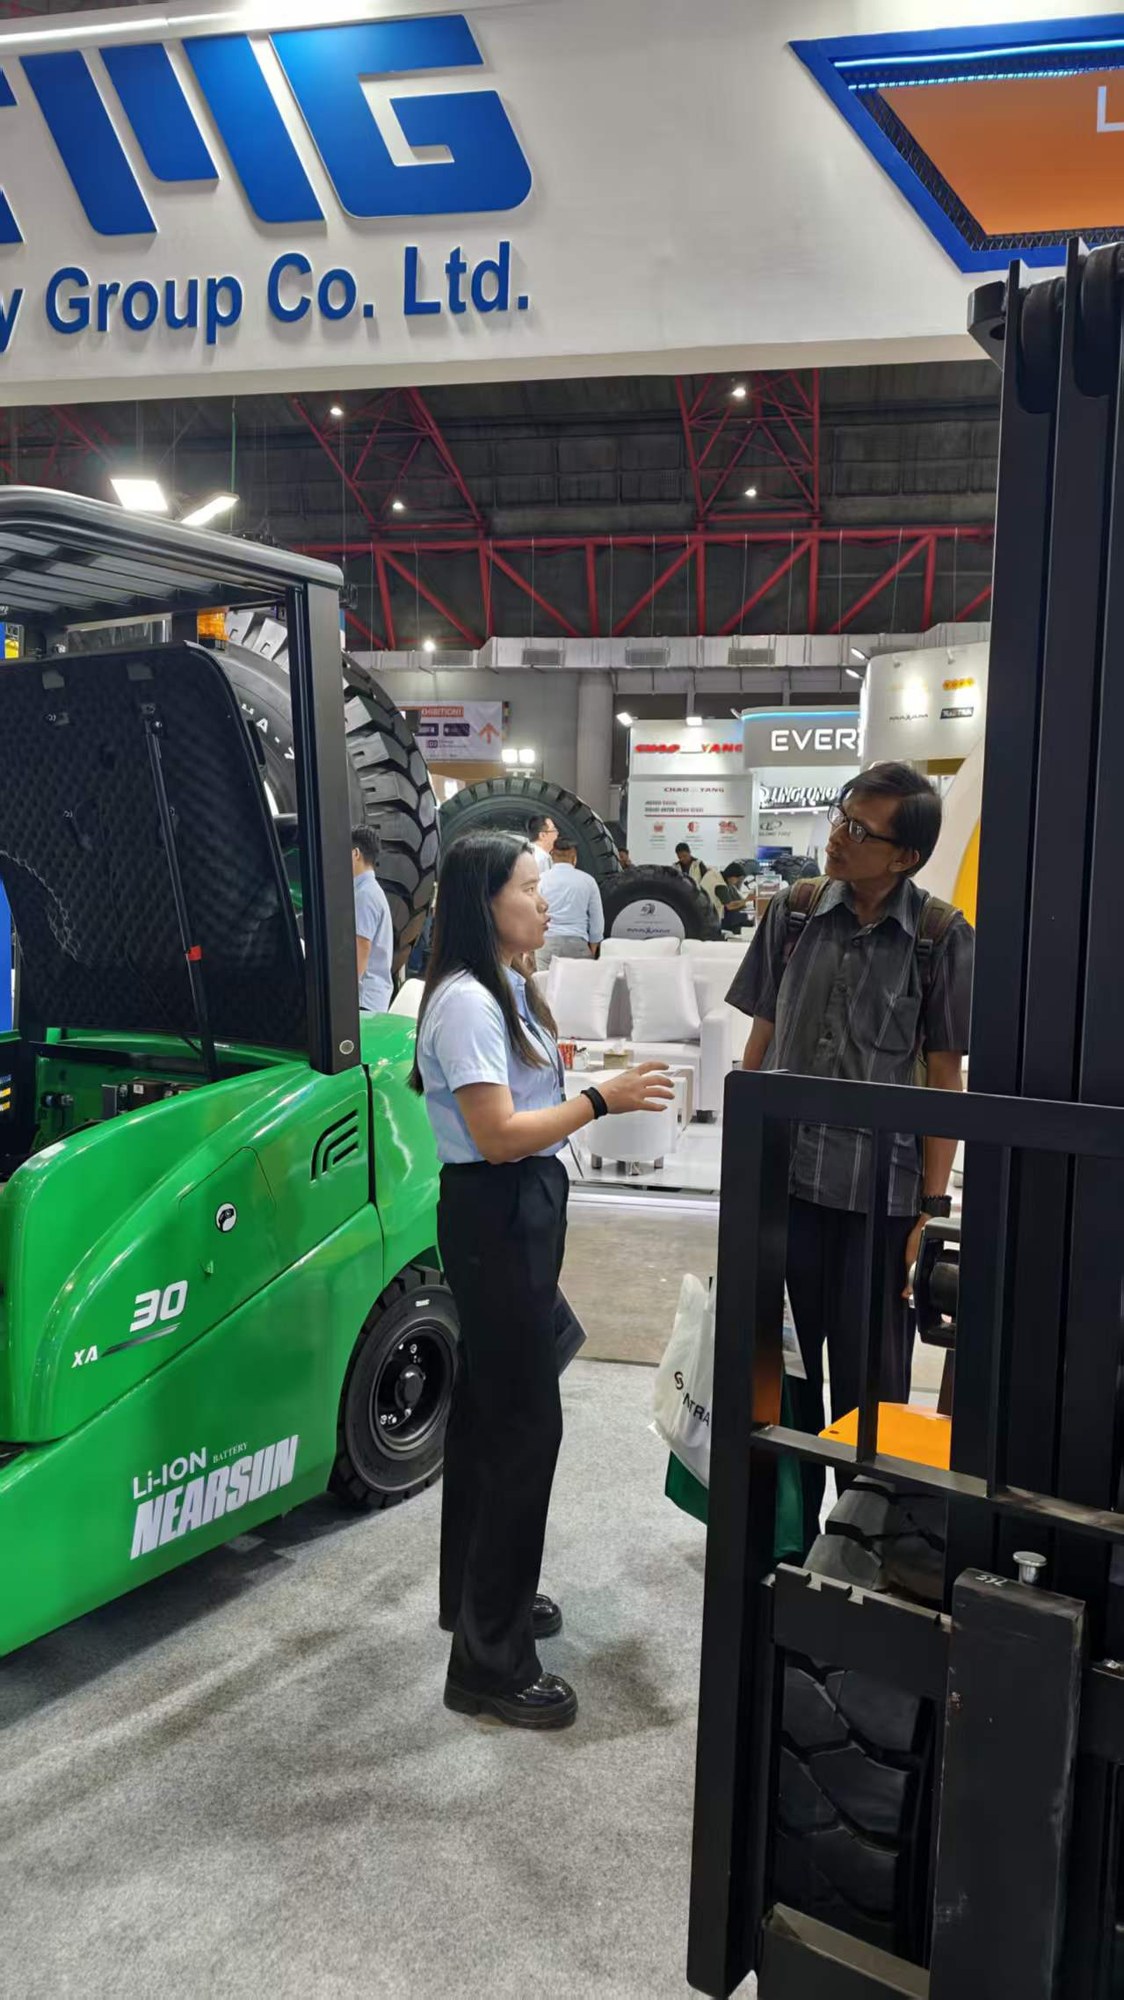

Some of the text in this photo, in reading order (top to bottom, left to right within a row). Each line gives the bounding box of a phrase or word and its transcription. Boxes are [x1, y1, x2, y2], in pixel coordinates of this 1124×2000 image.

[0, 15, 532, 246] MG
[46, 266, 243, 345] Group
[267, 252, 374, 323] Co.
[404, 241, 529, 315] Ltd.
[771, 728, 857, 751] EVER
[130, 1280, 188, 1332] 30
[71, 1345, 98, 1368] XA
[130, 1434, 299, 1560] NEARSUN
[133, 1442, 248, 1499] Li-ION BATTERY
